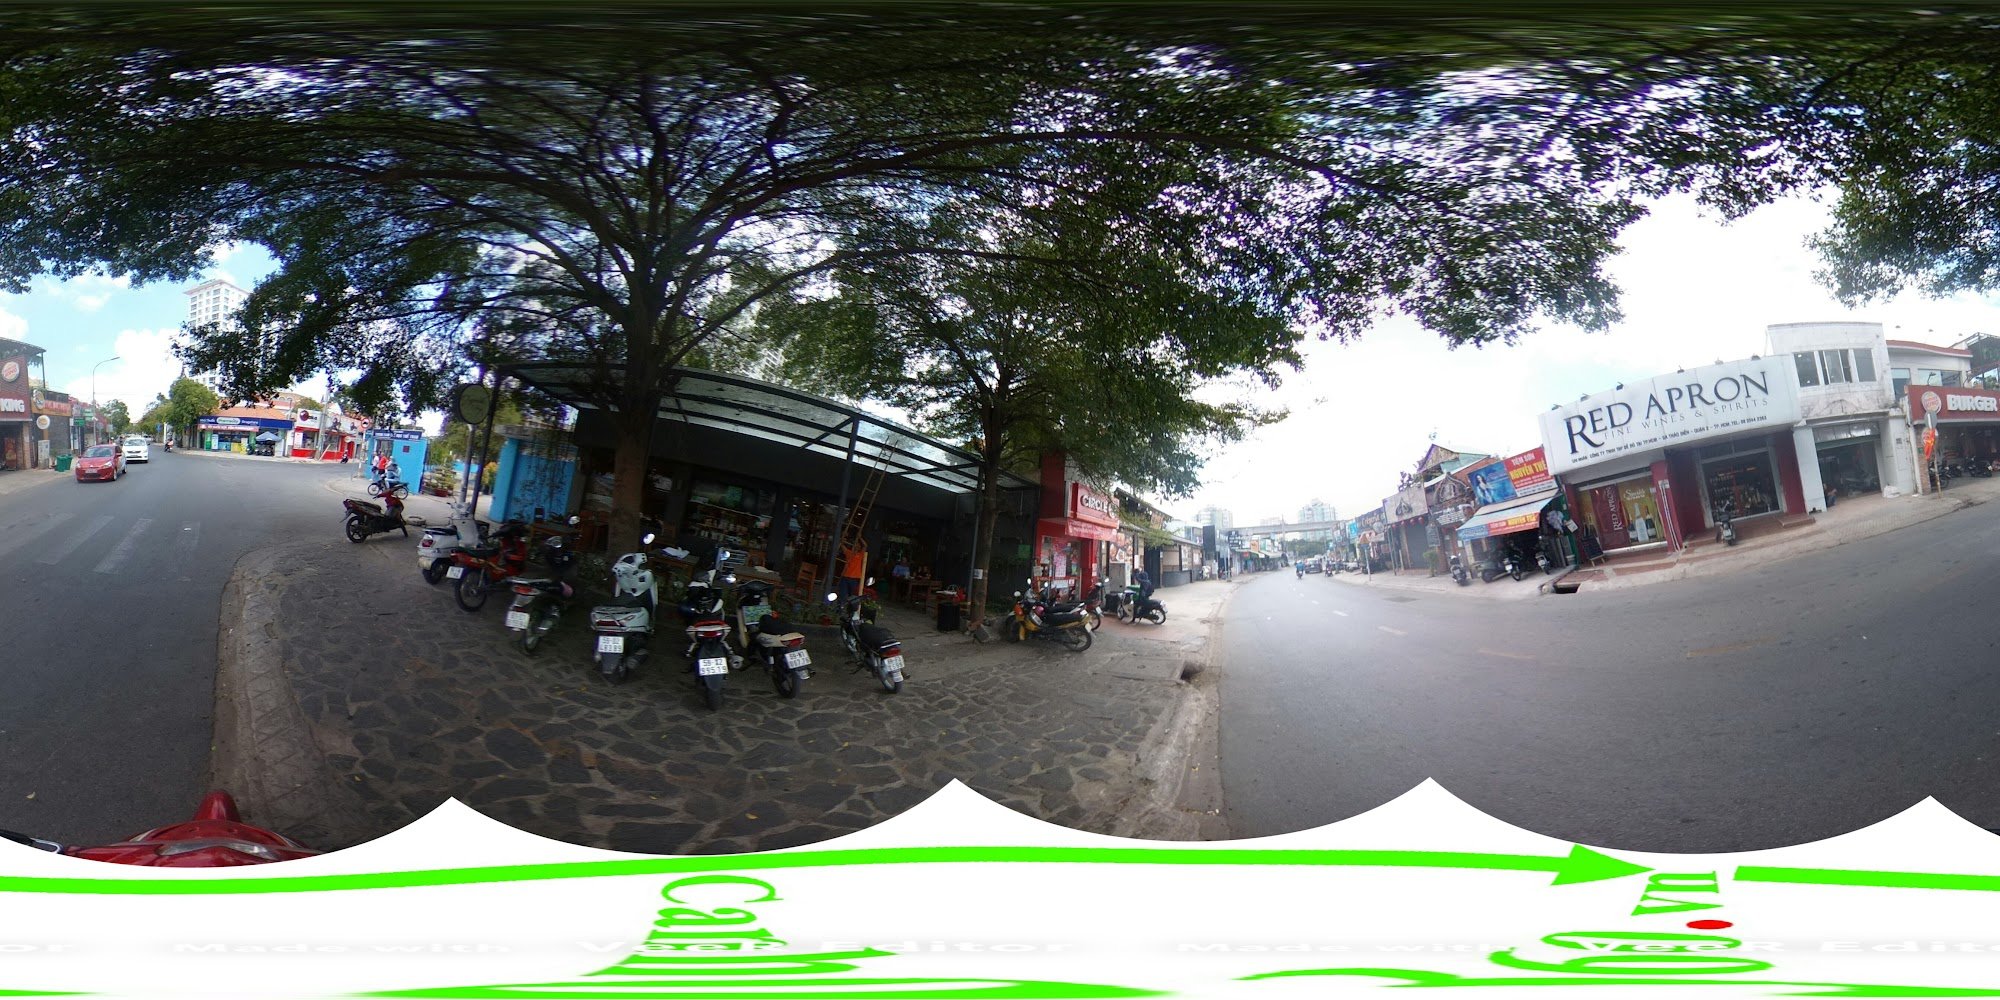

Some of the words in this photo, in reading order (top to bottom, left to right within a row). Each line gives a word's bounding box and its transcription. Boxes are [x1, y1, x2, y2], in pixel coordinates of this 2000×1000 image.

[0, 398, 25, 412] KING
[1563, 402, 1632, 454] RED
[1646, 371, 1768, 420] APRON
[1946, 394, 1998, 412] BURGER
[1604, 426, 1632, 440] FINE
[1641, 413, 1685, 430] WINES
[1695, 409, 1703, 418] &
[1713, 399, 1769, 415] SPIRITS
